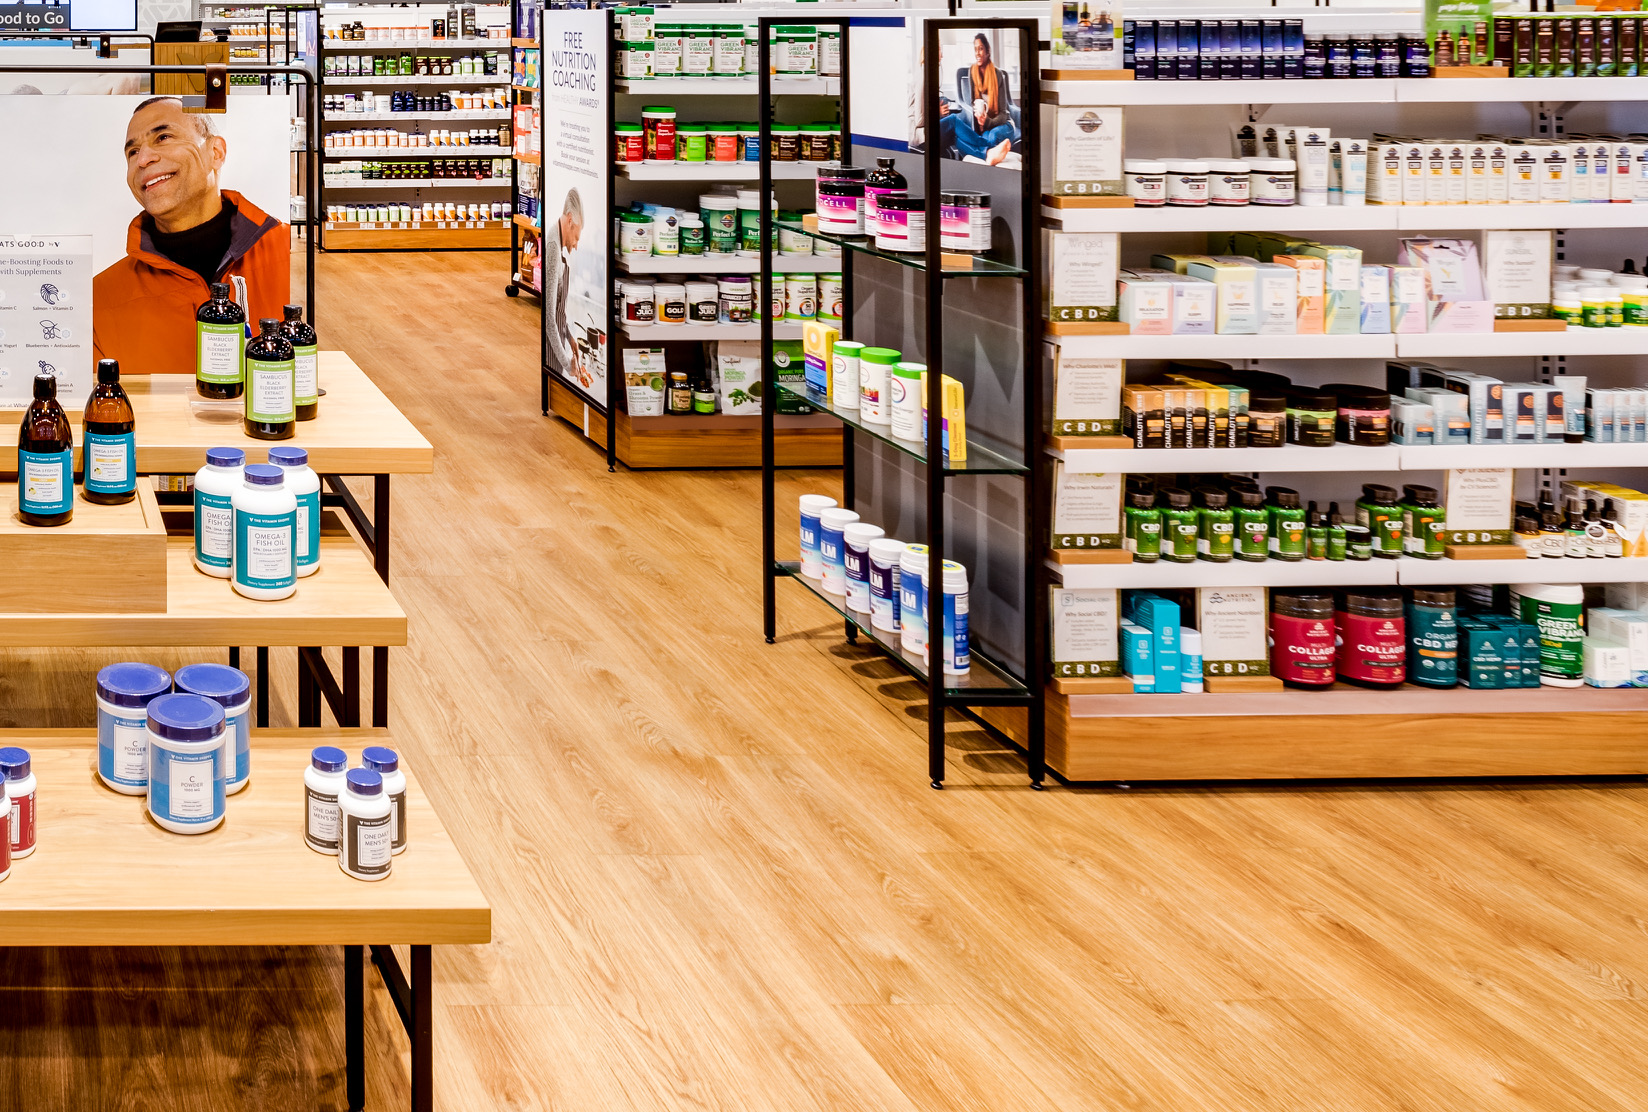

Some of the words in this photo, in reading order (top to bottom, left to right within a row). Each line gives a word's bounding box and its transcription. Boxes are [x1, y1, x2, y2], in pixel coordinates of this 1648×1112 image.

[26, 13, 41, 25] to
[44, 11, 64, 25] Go
[564, 31, 583, 50] FREE
[552, 50, 596, 71] NUTRITION
[553, 70, 596, 91] COACHING
[16, 268, 62, 277] Supplements
[1063, 422, 1101, 432] CBD
[1141, 522, 1160, 532] CBD
[1178, 524, 1197, 534] CBD
[1212, 523, 1234, 532] CBD
[1245, 522, 1268, 532] CBD
[1282, 521, 1305, 531] CBD
[1537, 619, 1576, 630] GREEN
[1413, 638, 1441, 648] CBD
[1062, 664, 1101, 674] CBD
[1209, 663, 1248, 673] CBD
